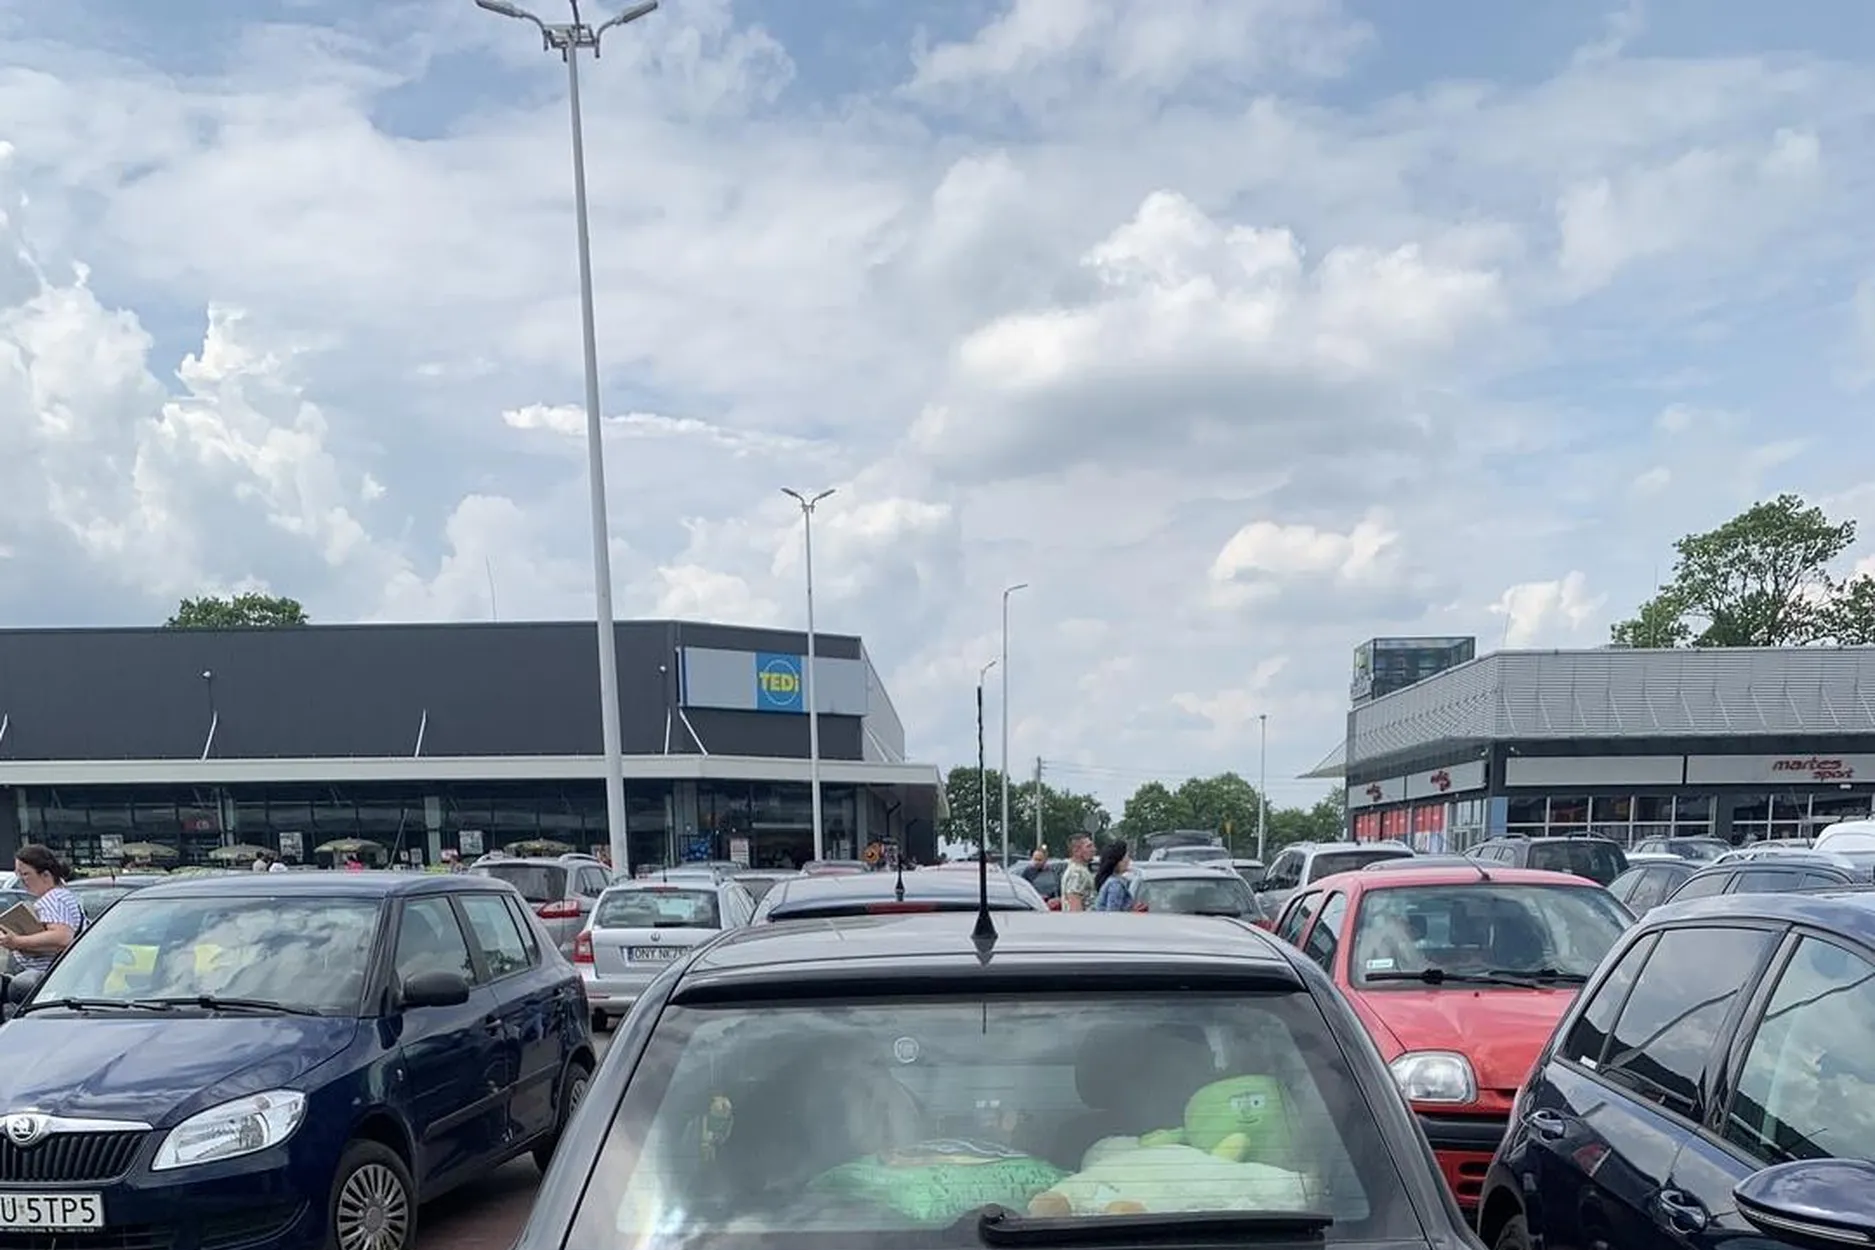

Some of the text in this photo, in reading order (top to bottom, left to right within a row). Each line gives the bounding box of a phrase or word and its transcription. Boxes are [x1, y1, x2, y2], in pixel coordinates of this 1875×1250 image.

[759, 671, 799, 694] TEDi
[1772, 757, 1842, 771] martes
[27, 1197, 96, 1223] 5TP5
